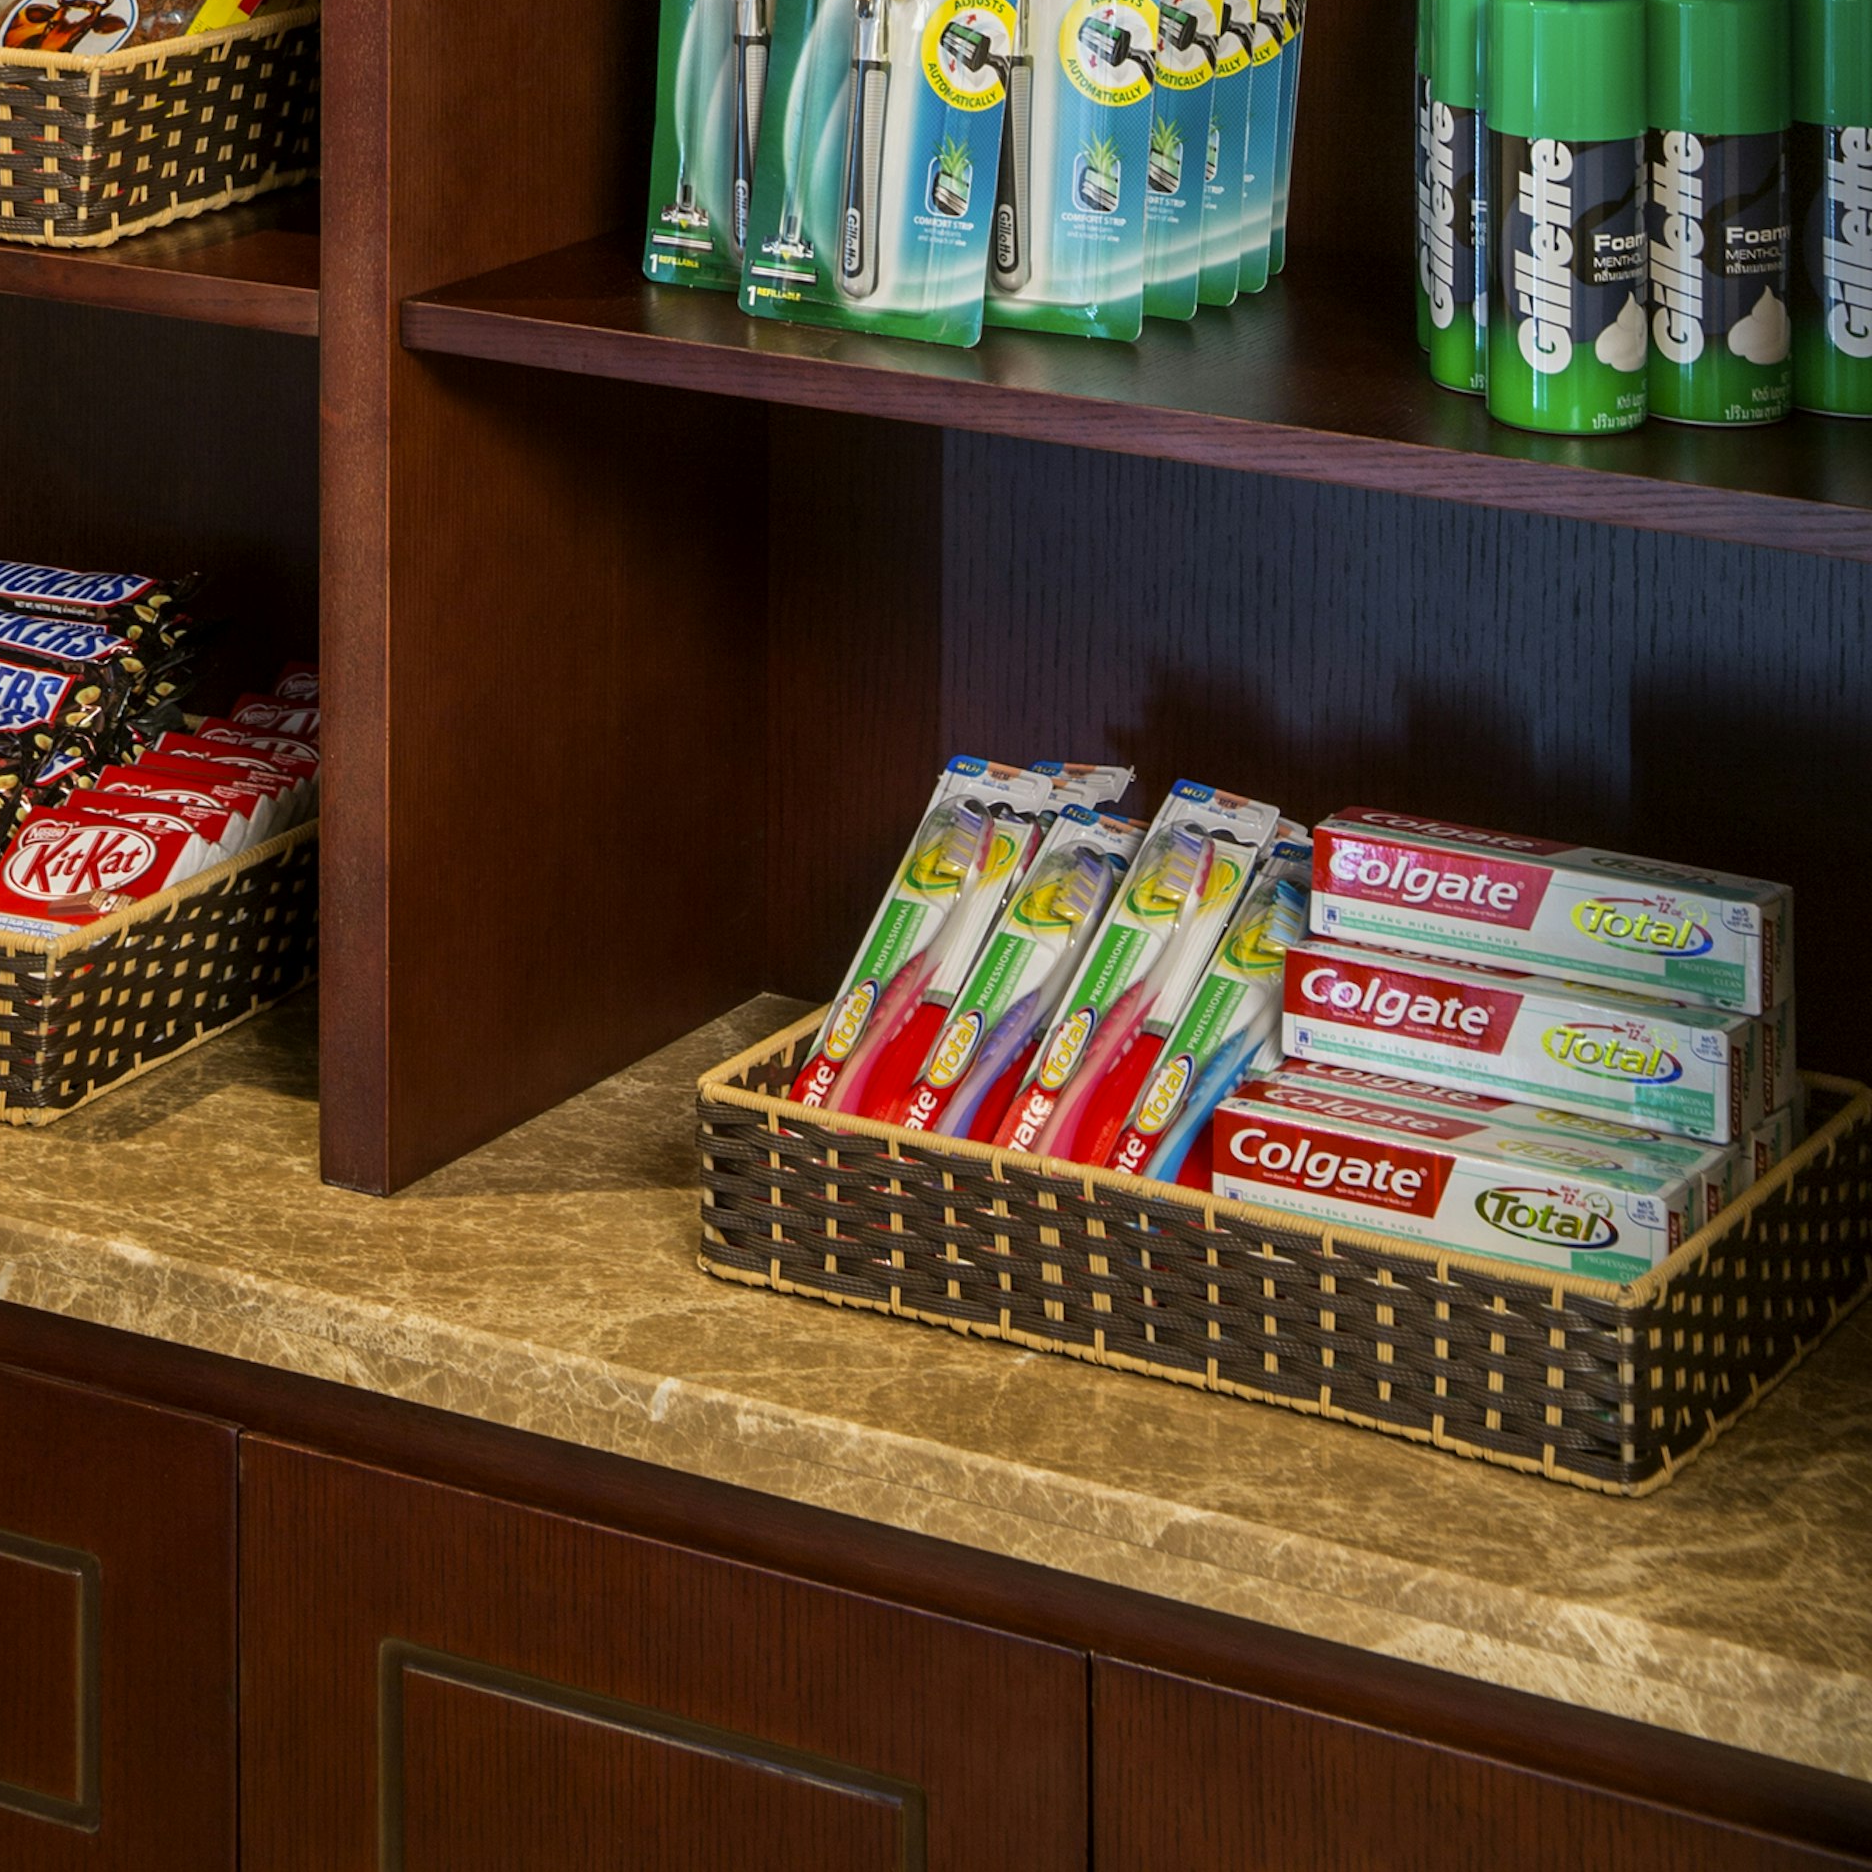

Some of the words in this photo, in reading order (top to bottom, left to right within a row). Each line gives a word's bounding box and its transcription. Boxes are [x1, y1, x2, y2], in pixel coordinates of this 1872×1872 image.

[1515, 138, 1573, 374] Gillette
[1651, 130, 1704, 364] Gillette
[22, 832, 142, 893] KitKat
[1329, 843, 1519, 912] Colgate
[872, 902, 912, 975] PROFESSIONAL
[1586, 900, 1694, 950] Total
[977, 936, 1020, 1006] PROFESSIONAL
[1301, 968, 1489, 1036] Colgate
[829, 991, 873, 1055] Total
[930, 1016, 980, 1086] Total
[1264, 1088, 1439, 1132] Colgate
[1230, 1128, 1422, 1198] Colgate
[1488, 1193, 1600, 1242] Total
[1562, 1194, 1576, 1205] 12
